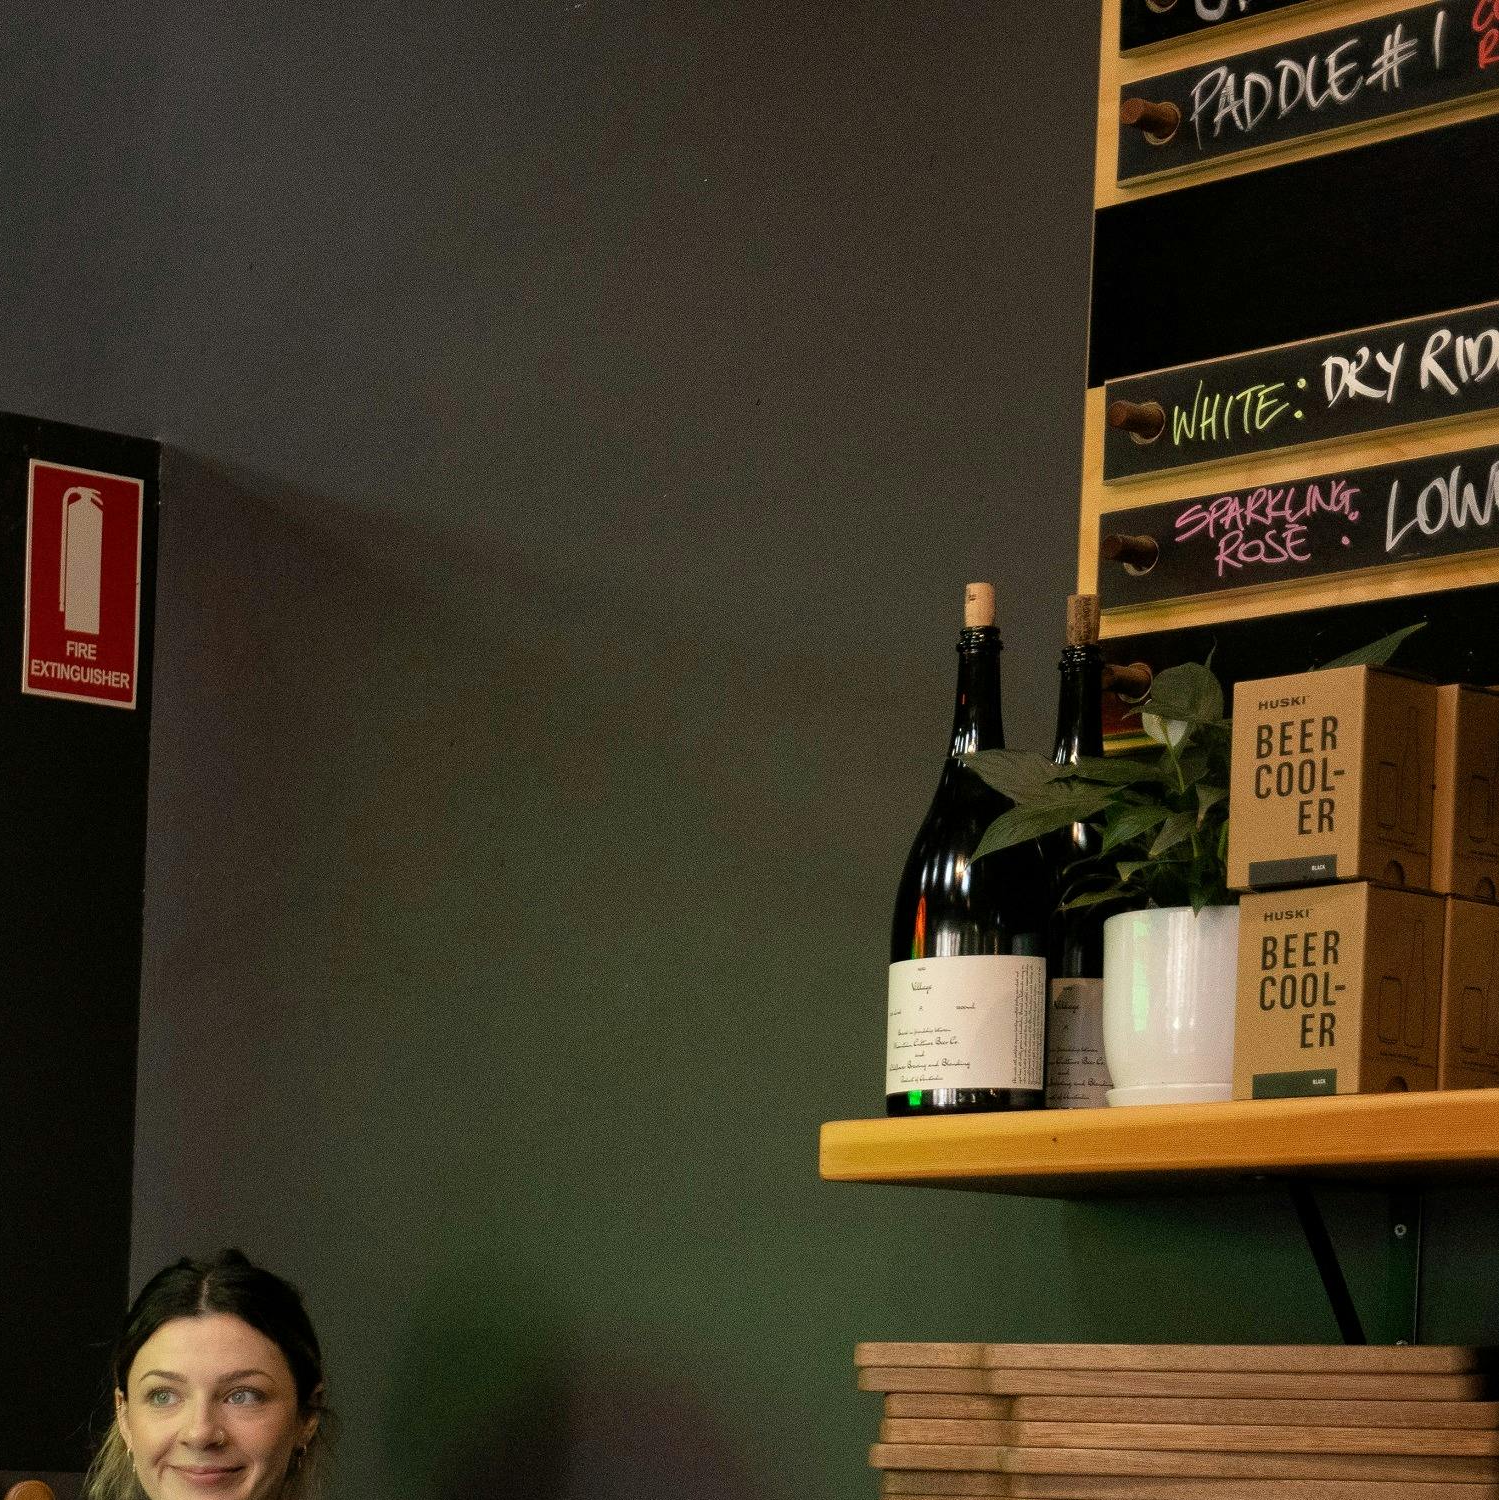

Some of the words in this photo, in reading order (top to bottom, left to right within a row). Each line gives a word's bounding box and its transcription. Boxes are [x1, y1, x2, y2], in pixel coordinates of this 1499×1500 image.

[1190, 38, 1364, 150] PADDLE
[1321, 343, 1405, 408] DRY
[1420, 328, 1499, 396] RID
[1174, 480, 1362, 542] SPARKLING
[1385, 461, 1499, 553] LOW
[66, 640, 97, 661] FIRE
[31, 658, 130, 689] EXTINGUISHER
[1258, 696, 1306, 711] HUSKI
[1255, 715, 1339, 759] BEER
[1254, 757, 1345, 799] COOL-
[1298, 797, 1335, 836] ER
[1264, 909, 1310, 921] HUSKI
[1260, 930, 1340, 971] BEER
[1259, 971, 1346, 1011] COOL-
[1299, 1012, 1336, 1049] ER
